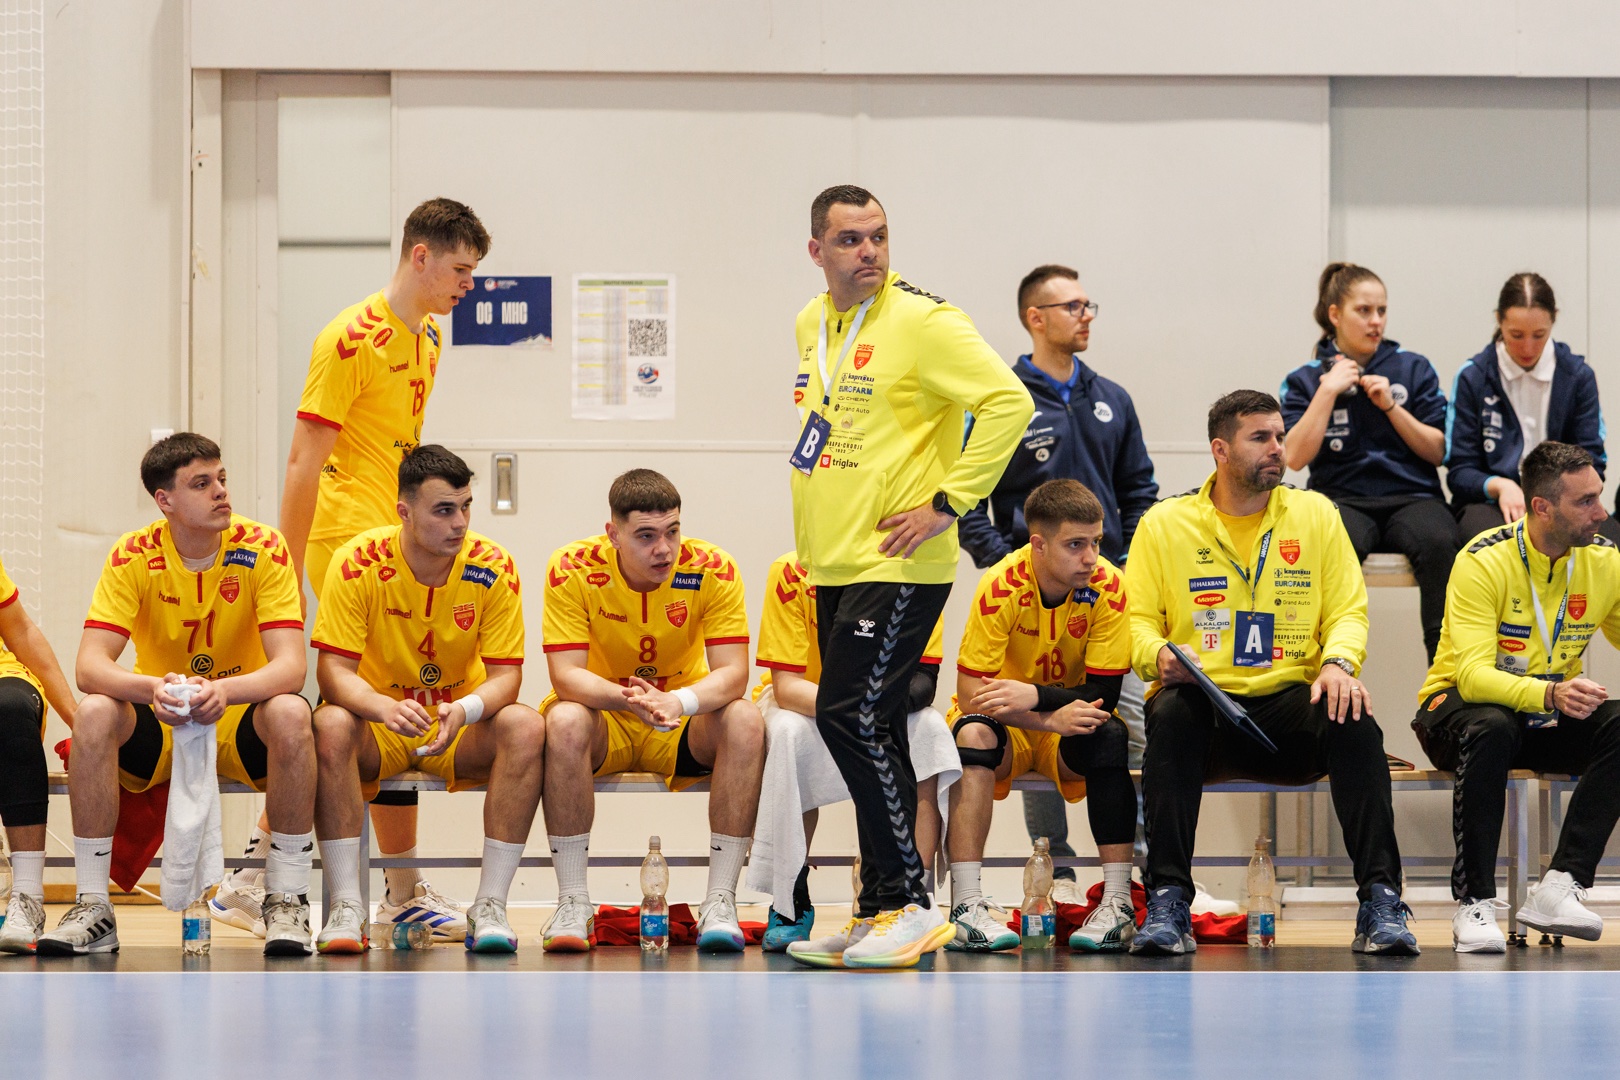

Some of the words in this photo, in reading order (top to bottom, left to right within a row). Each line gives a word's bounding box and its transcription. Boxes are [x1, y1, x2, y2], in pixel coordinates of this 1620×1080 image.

[502, 301, 528, 325] MHC
[838, 386, 873, 395] EUROFARM
[856, 406, 870, 414] Auto
[801, 427, 820, 459] B
[832, 458, 859, 469] triglav
[1196, 579, 1227, 588] HALKBANK
[1197, 595, 1223, 603] Maggi
[598, 606, 628, 622] hummel
[181, 609, 216, 654] 71
[853, 629, 875, 638] hummel
[1560, 634, 1592, 642] EUROFAR
[417, 630, 438, 661] 4
[1244, 624, 1263, 654] A
[638, 635, 658, 664] 8
[1285, 649, 1307, 660] trigla
[1035, 647, 1067, 682] 18
